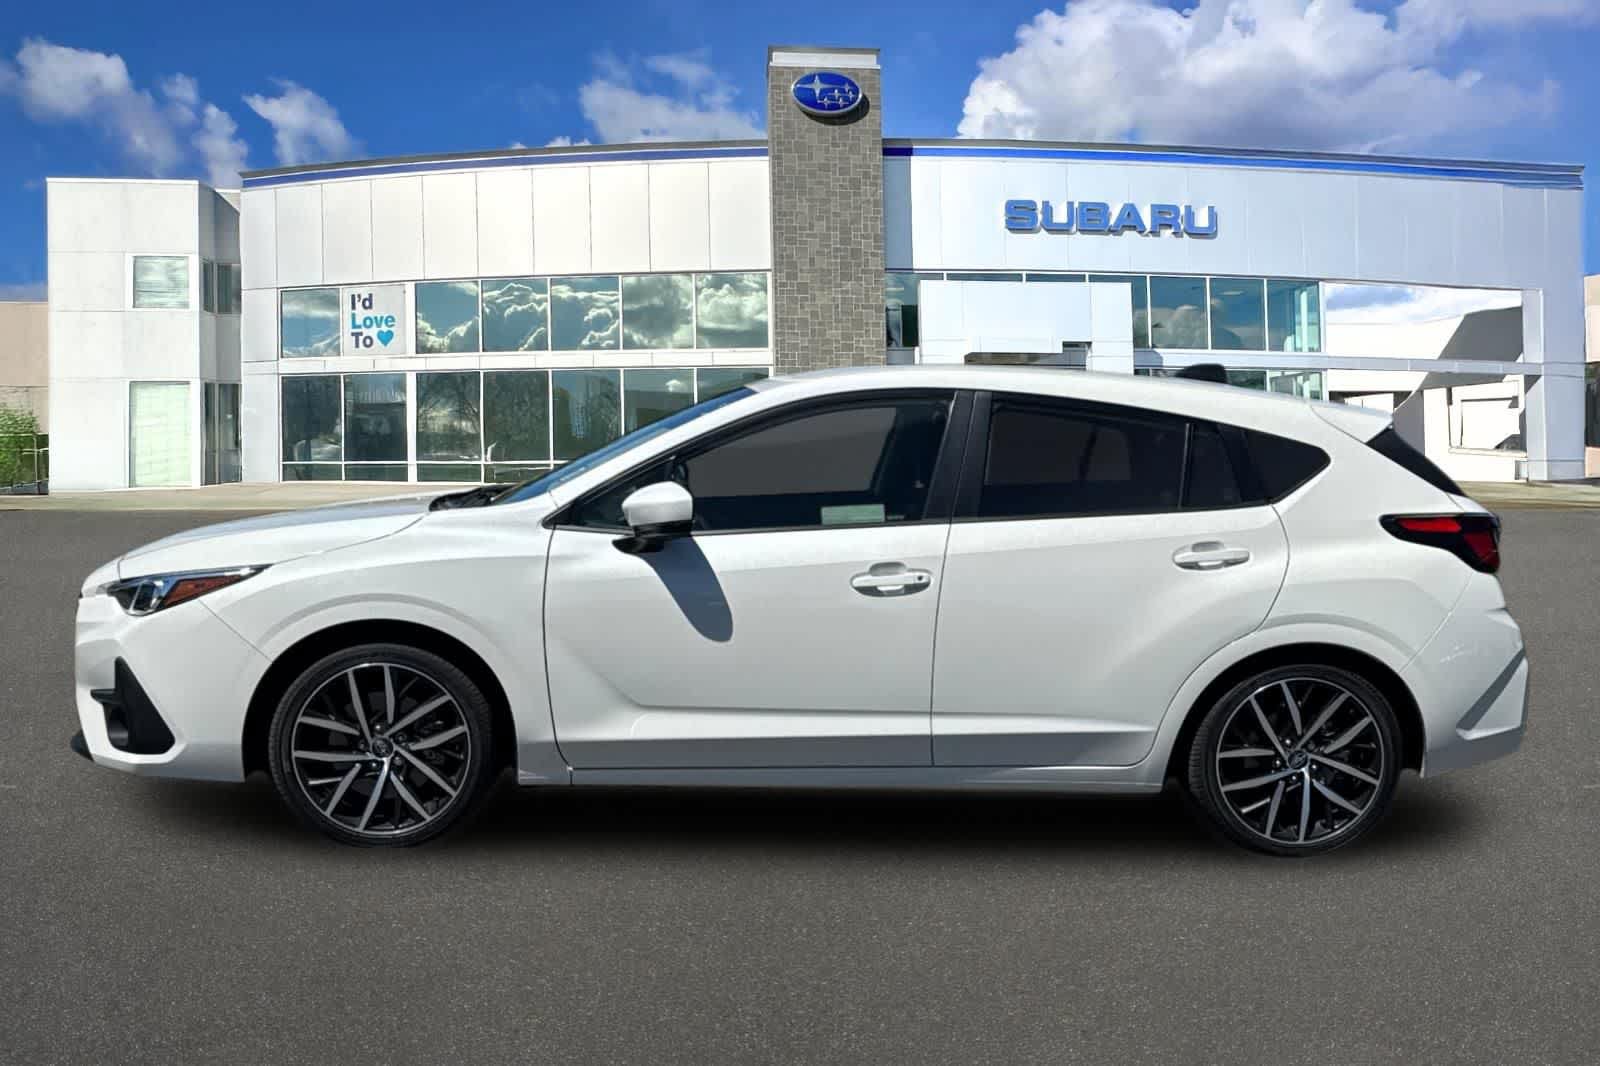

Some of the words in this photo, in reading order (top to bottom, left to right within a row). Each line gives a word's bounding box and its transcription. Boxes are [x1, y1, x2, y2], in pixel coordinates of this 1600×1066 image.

[1004, 199, 1218, 238] SUBARU
[351, 293, 373, 310] I'd
[351, 312, 396, 329] Love
[351, 331, 374, 348] To
